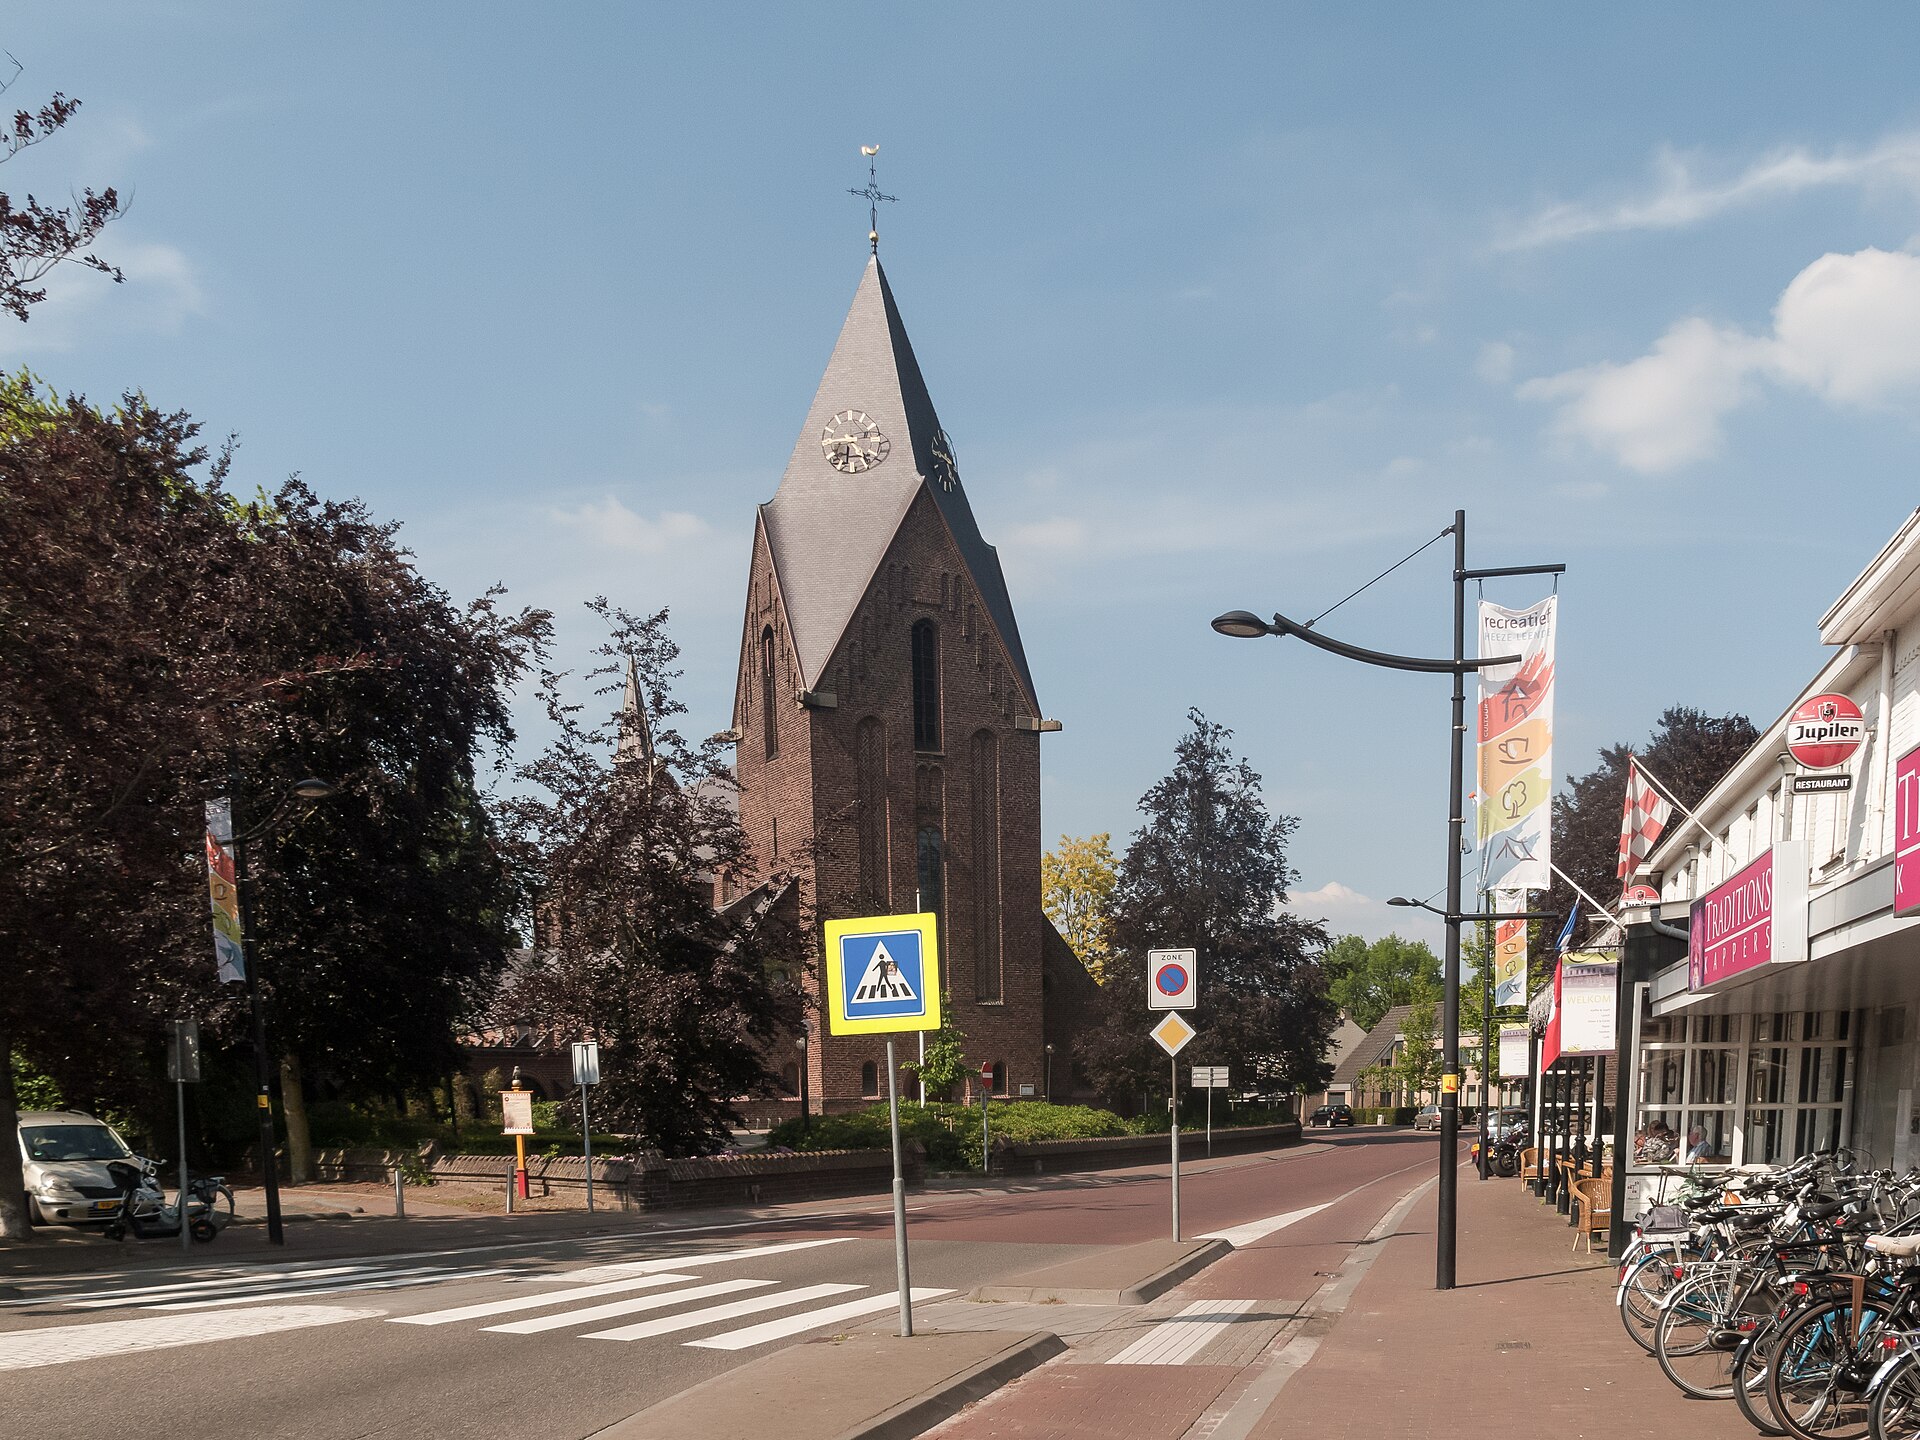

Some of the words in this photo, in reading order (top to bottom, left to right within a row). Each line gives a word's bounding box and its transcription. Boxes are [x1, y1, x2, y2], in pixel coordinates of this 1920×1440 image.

[1485, 606, 1552, 629] recreatief
[1794, 723, 1859, 741] Jupiler
[1795, 778, 1850, 789] RESTAURANT
[1705, 867, 1772, 942] TRADITIONS
[1704, 926, 1771, 974] KAPPERS
[1567, 994, 1611, 1005] WELKOM
